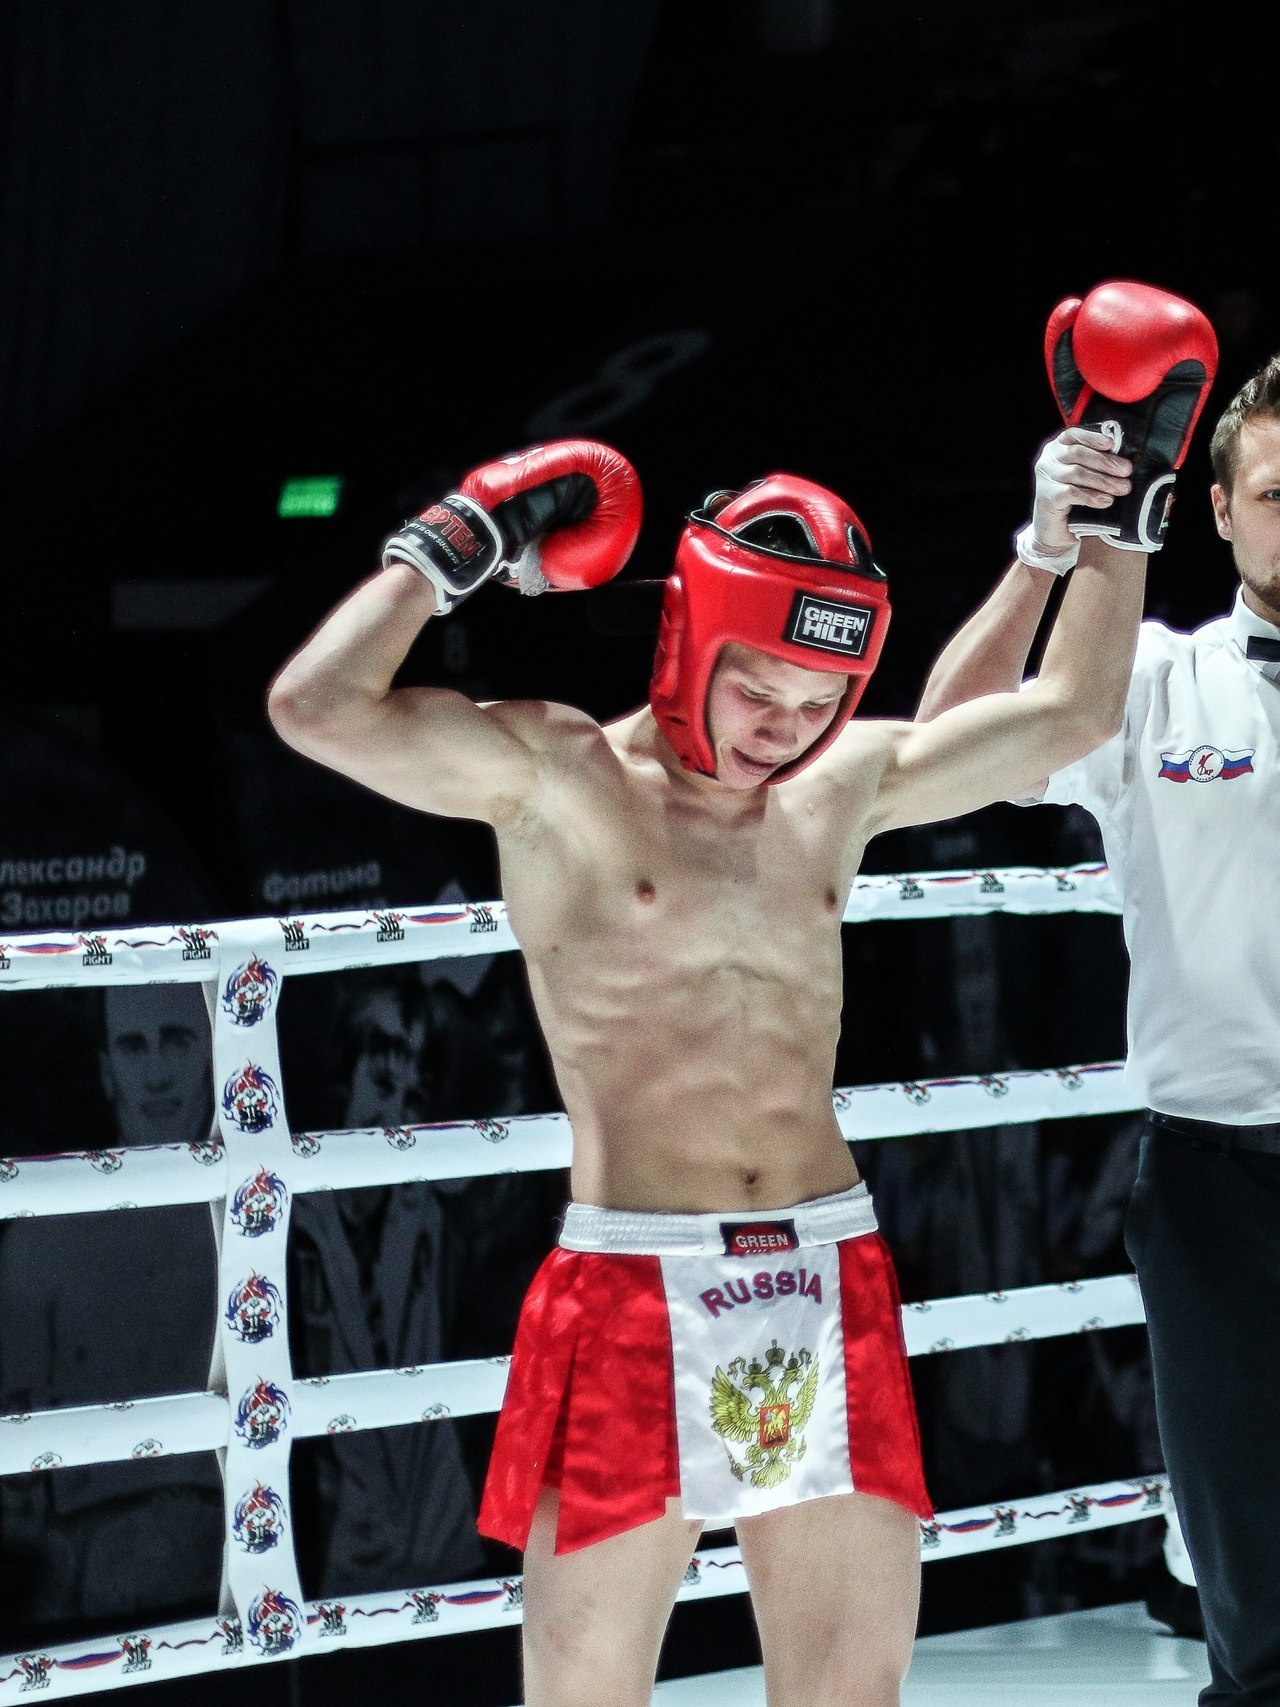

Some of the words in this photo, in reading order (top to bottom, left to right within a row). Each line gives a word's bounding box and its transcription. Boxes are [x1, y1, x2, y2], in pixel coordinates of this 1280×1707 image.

[441, 514, 481, 560] TEN
[804, 606, 865, 632] GREEN
[802, 619, 853, 645] HILL
[470, 922, 497, 933] FIGHT
[378, 931, 404, 942] FIGHT
[84, 954, 111, 966] FIGHT
[184, 949, 210, 960] FIGHT
[735, 1233, 789, 1248] GREEN
[699, 1268, 823, 1318] RUSSIA
